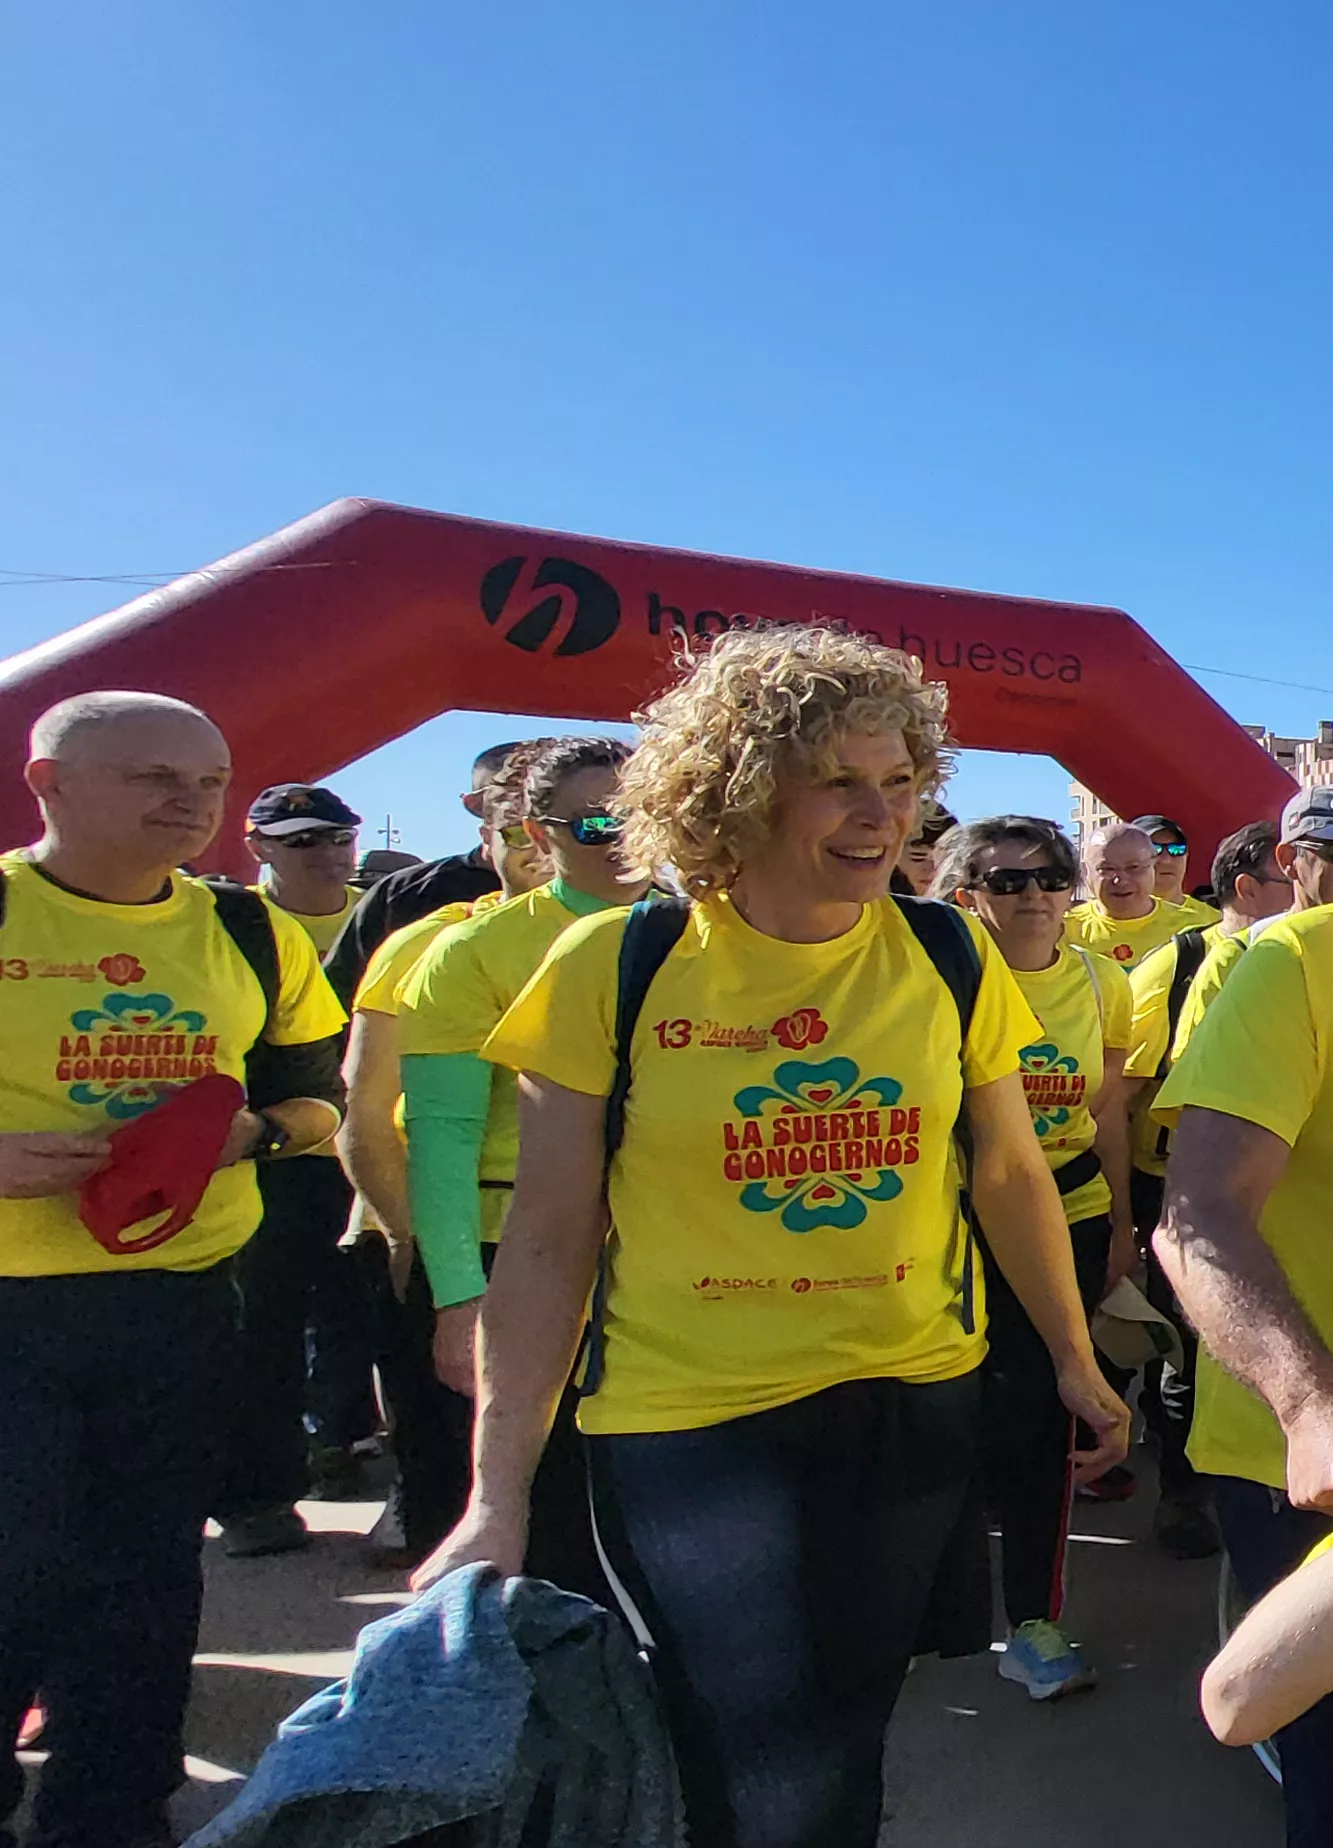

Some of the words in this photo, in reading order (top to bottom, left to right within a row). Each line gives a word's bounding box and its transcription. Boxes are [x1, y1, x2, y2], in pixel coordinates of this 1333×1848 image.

[899, 623, 1083, 684] huesca
[653, 1019, 693, 1050] 13
[724, 1121, 763, 1151] LA
[772, 1110, 880, 1147] SUERTE
[889, 1106, 922, 1136] DE
